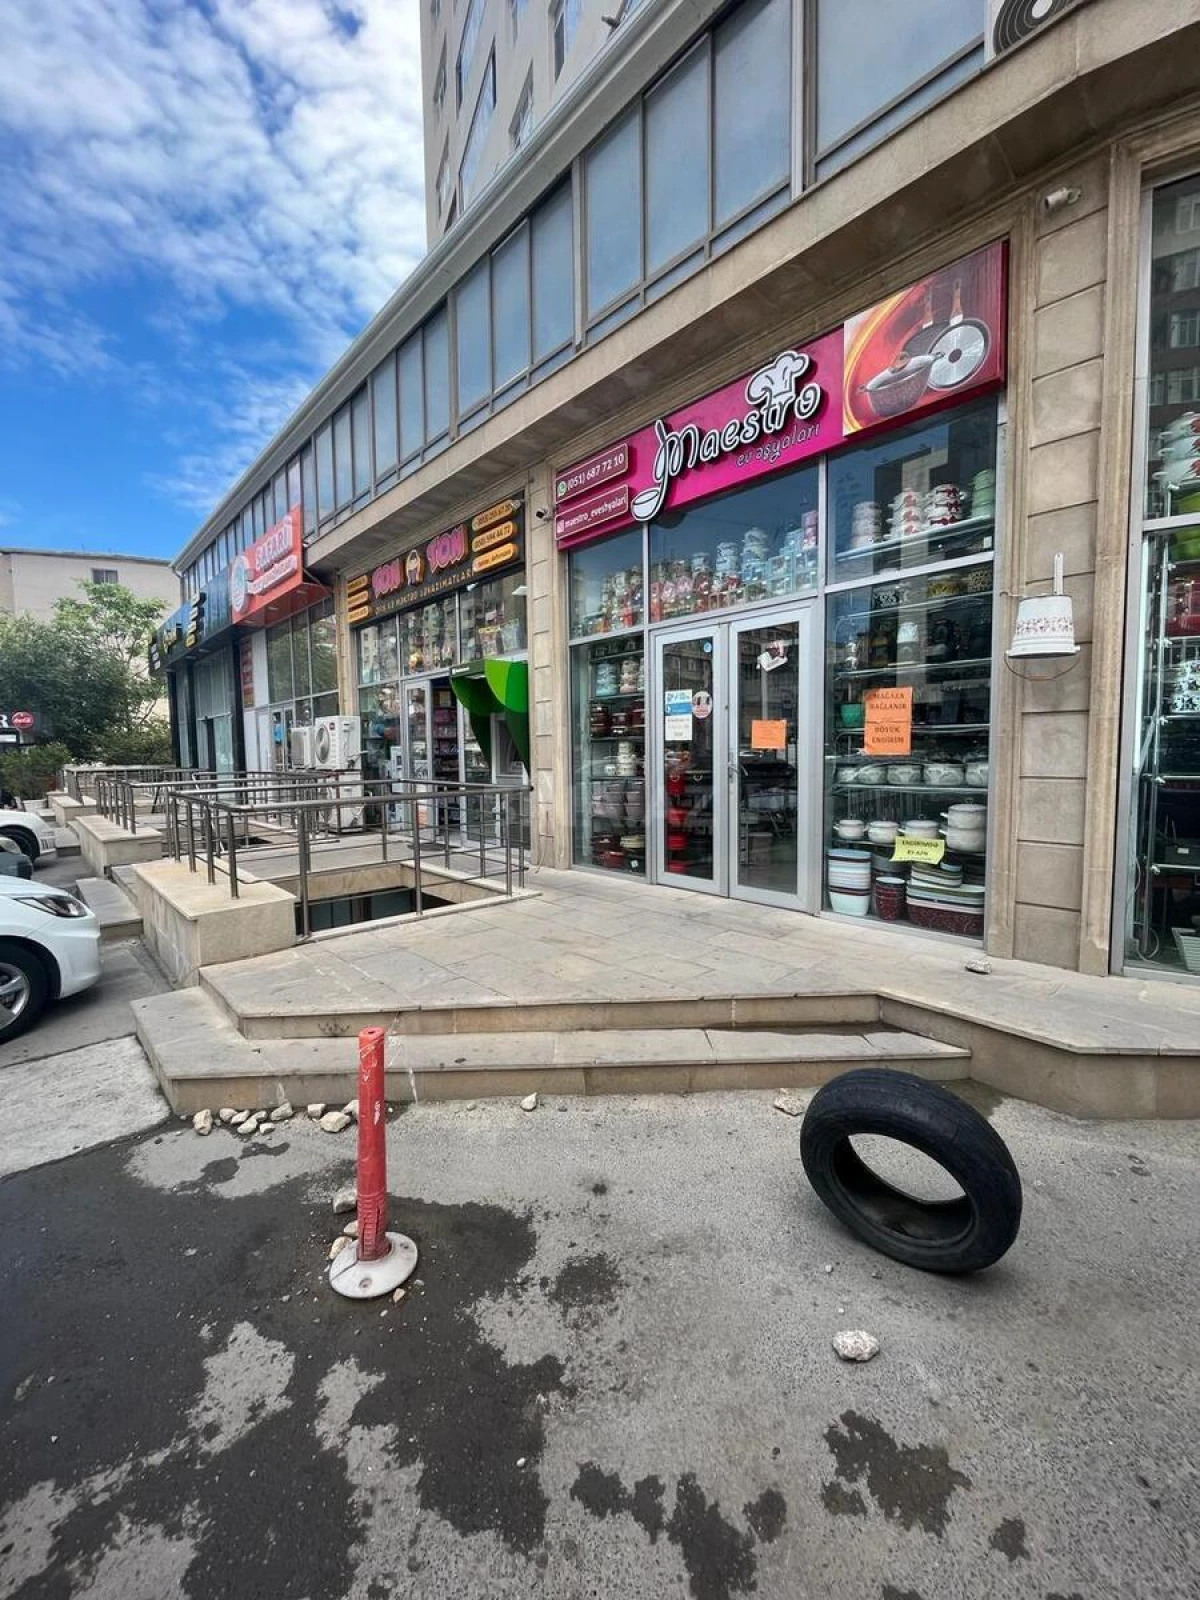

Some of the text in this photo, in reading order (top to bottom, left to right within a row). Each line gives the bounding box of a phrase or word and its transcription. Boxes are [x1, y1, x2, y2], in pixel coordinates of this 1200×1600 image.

[567, 452, 625, 491] (051) 687 72 10
[634, 382, 821, 520] Maestro
